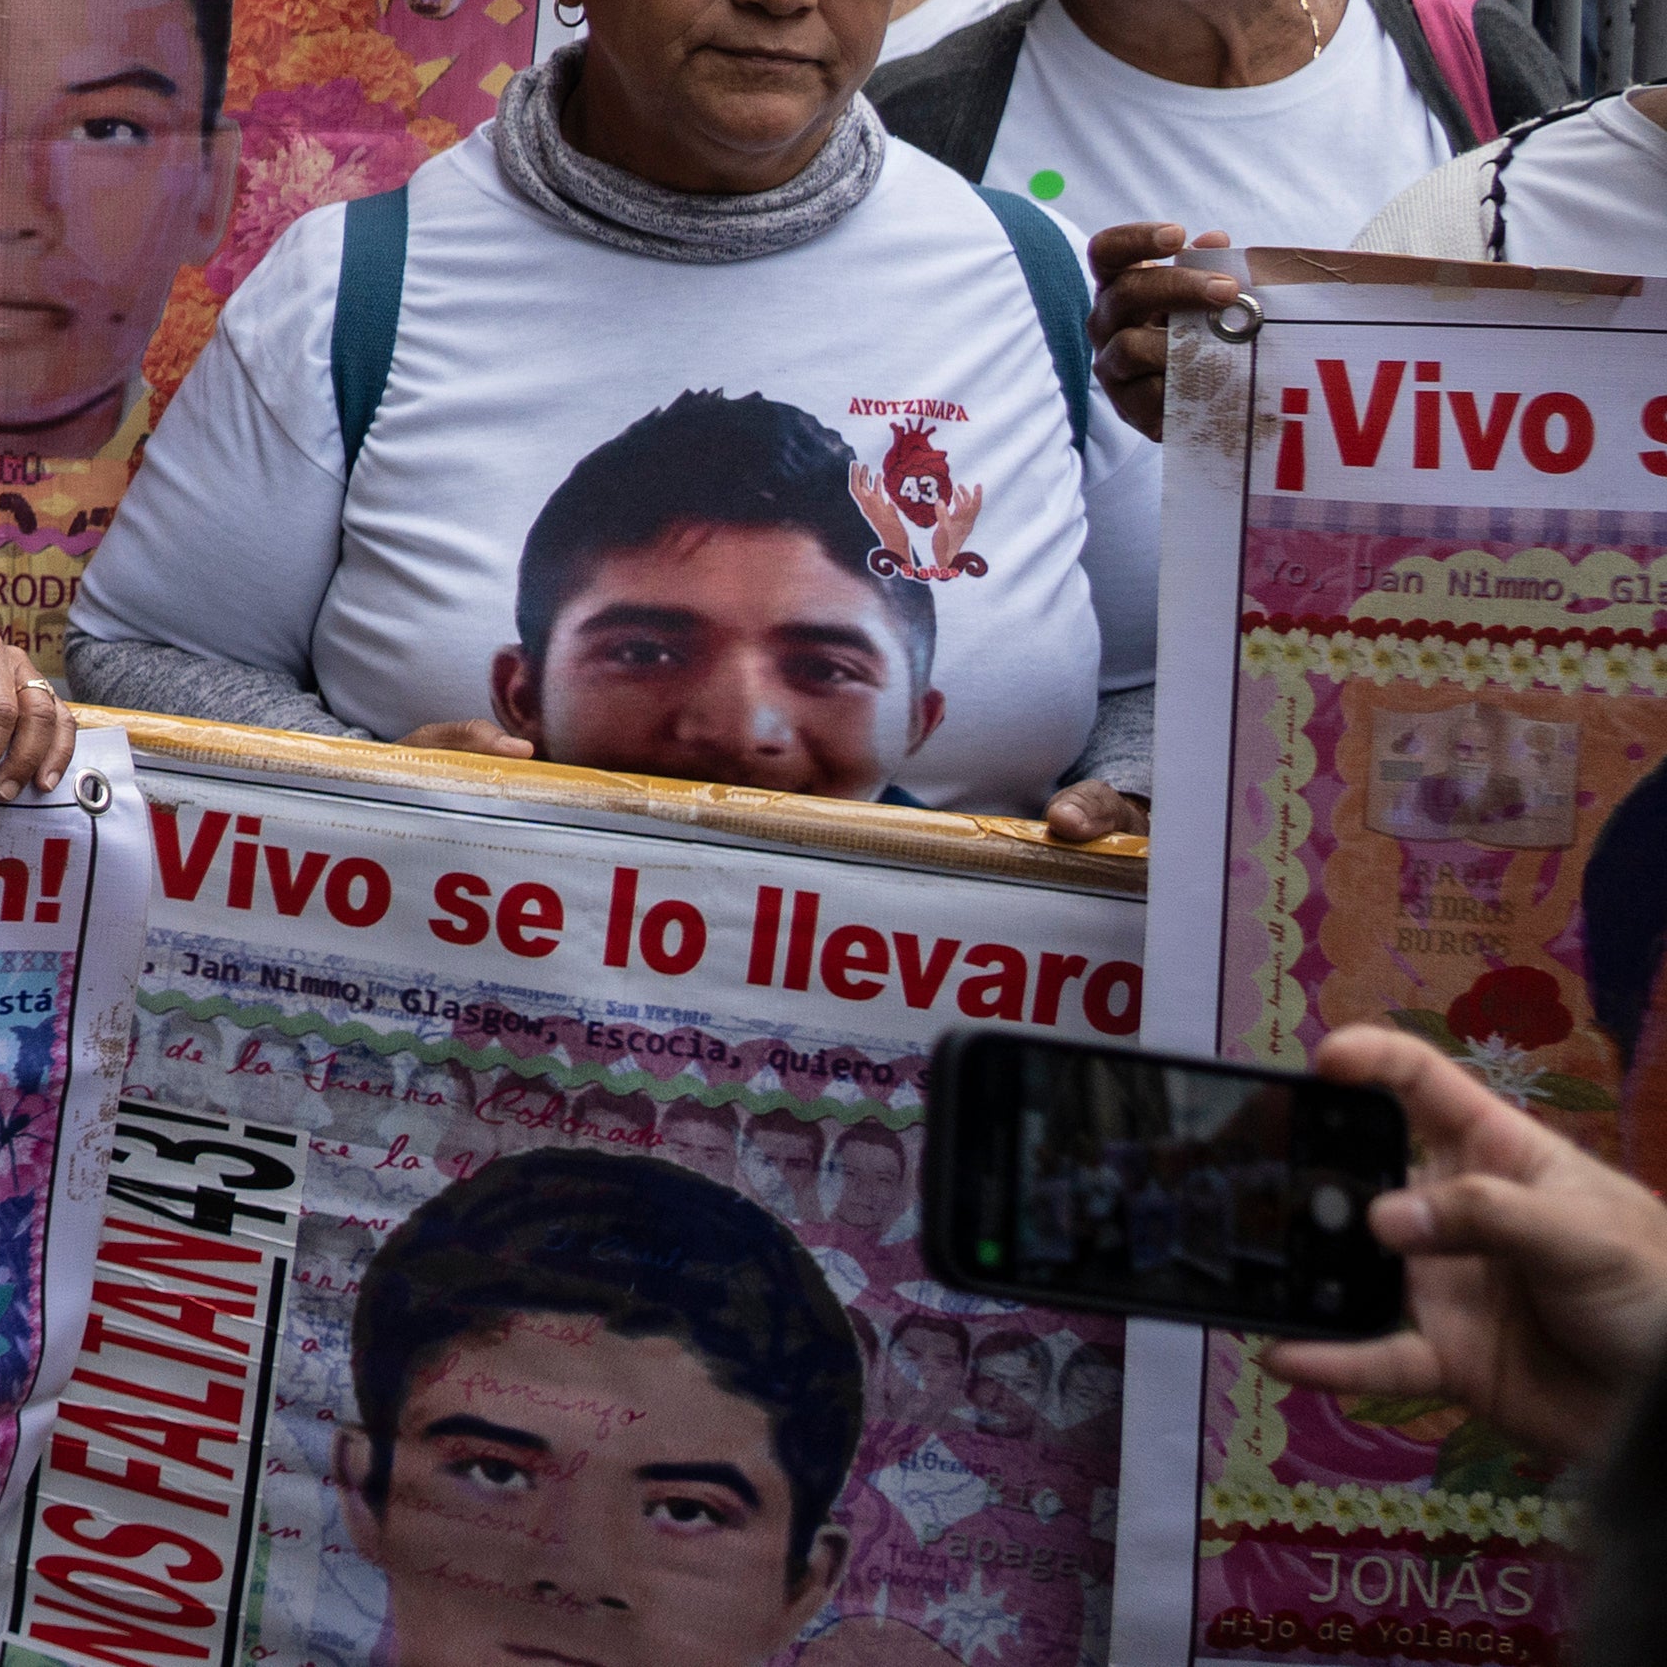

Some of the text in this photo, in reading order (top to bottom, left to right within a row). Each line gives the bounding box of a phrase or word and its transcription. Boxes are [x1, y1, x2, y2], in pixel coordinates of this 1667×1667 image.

[848, 396, 970, 422] AYOTZINAPA
[1276, 360, 1593, 491] ¡Vivo
[899, 475, 940, 505] 43
[1357, 565, 1425, 596] Jan
[1448, 569, 1581, 606] Nimmo,
[429, 873, 563, 957] se
[605, 867, 706, 974] lo
[182, 952, 241, 983] Jan
[259, 966, 376, 1012] Nimmo,
[400, 986, 558, 1046] Glasgow,
[585, 1019, 742, 1070] Escocia,
[767, 1042, 896, 1088] quiero
[50, 1216, 264, 1518] FALTAN
[25, 1504, 224, 1667] NOS
[1307, 1550, 1535, 1617] JONÁS
[1219, 1612, 1532, 1660] Hijo de Yolanda,
